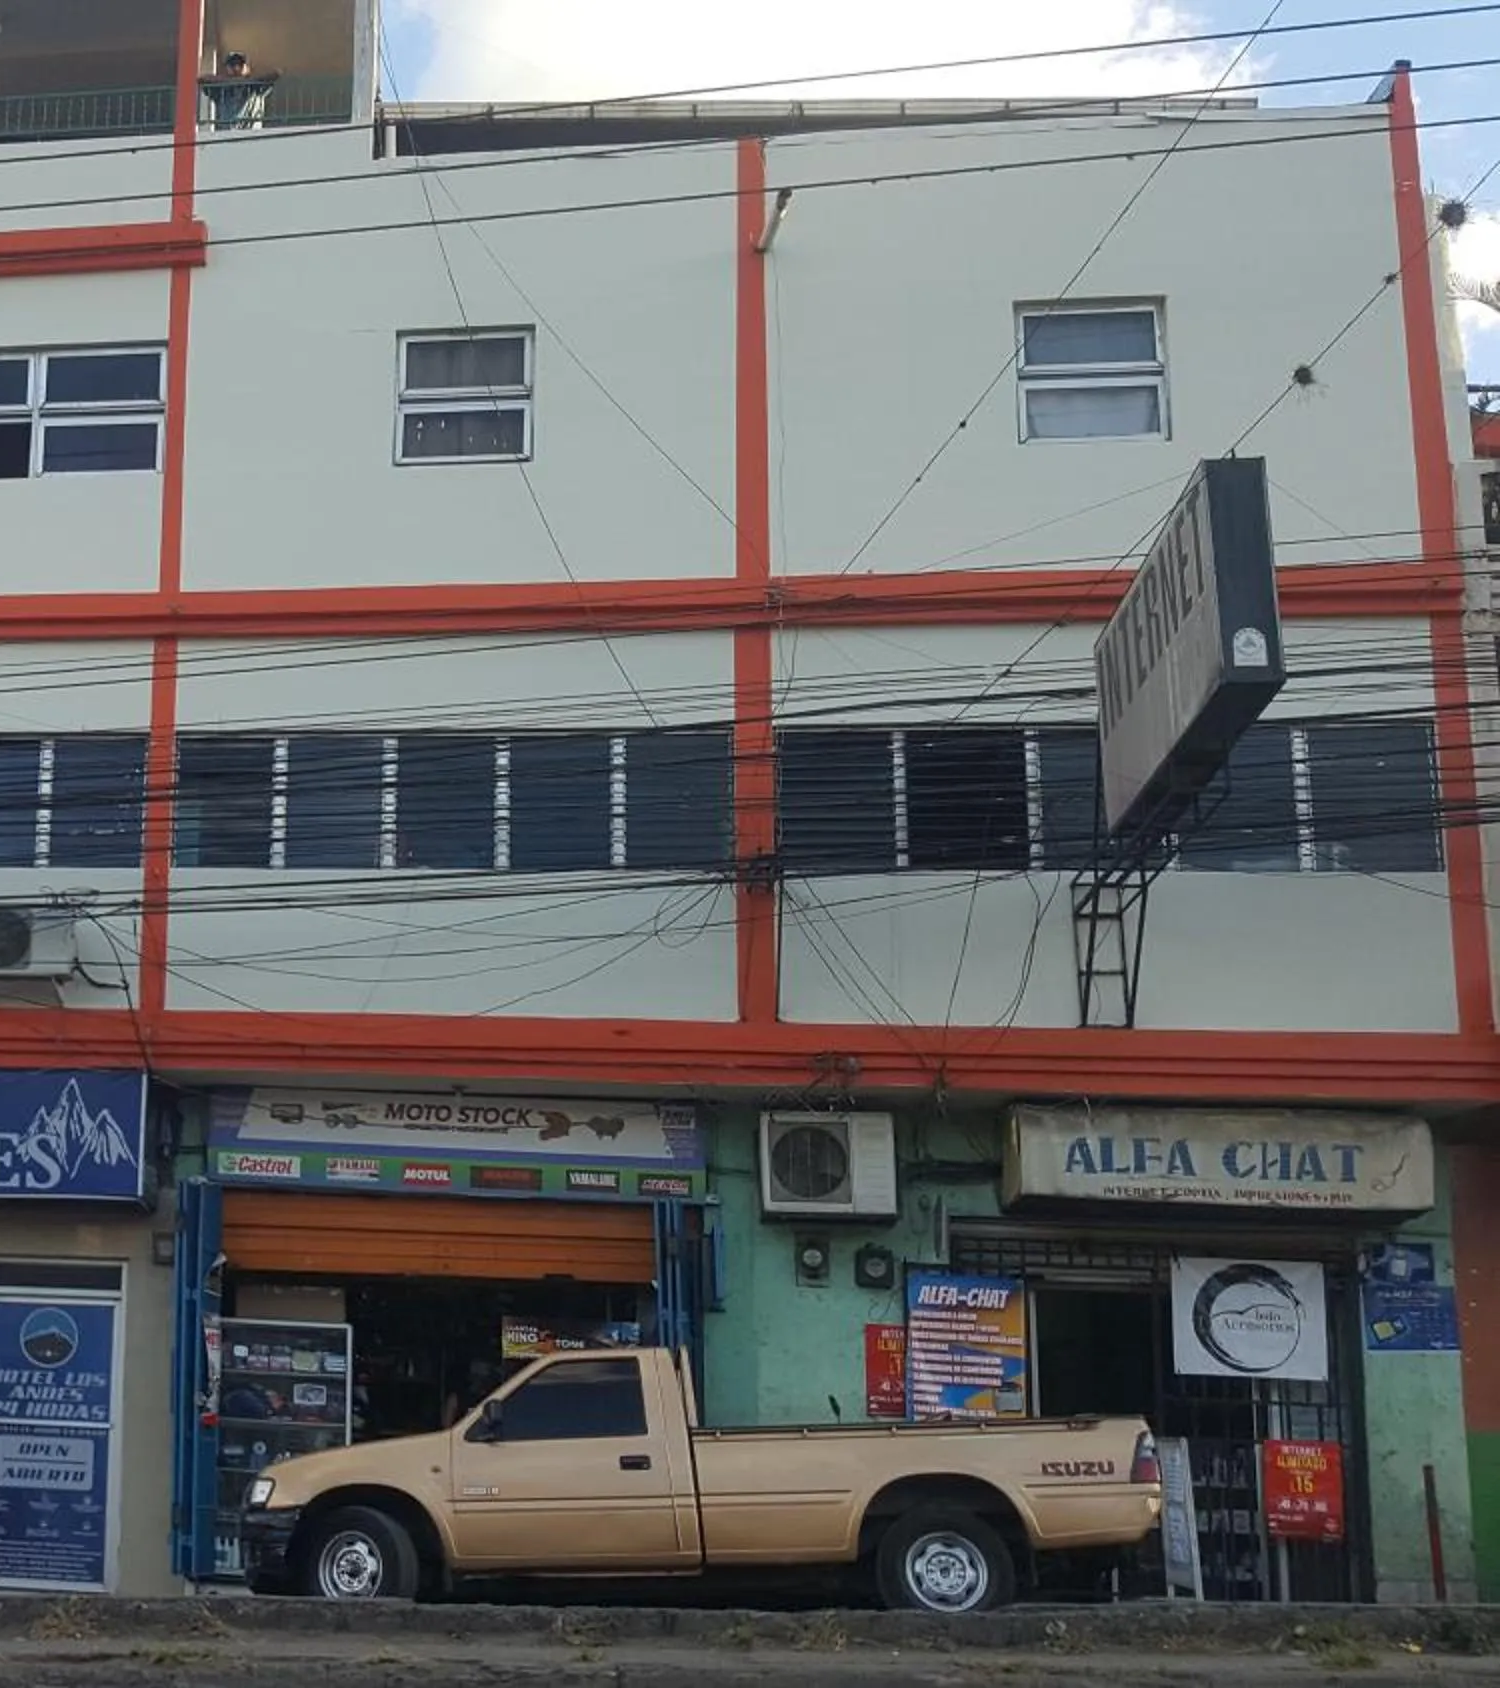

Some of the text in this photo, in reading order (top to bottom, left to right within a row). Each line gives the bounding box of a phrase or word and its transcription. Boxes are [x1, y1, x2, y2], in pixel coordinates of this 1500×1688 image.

[1098, 487, 1208, 741] INTERNET
[385, 1103, 451, 1122] MOTO
[457, 1106, 535, 1126] STOCK
[239, 1155, 293, 1174] Castrol
[1065, 1136, 1365, 1183] ALFA CHAT
[404, 1167, 450, 1181] MOTUL
[918, 1284, 1009, 1309] ALFA-CHAT
[65, 1371, 106, 1387] LOS
[8, 1384, 84, 1402] ANDES
[25, 1401, 106, 1420] HORAS
[18, 1442, 70, 1457] OPEN
[3, 1467, 86, 1483] ABIERTO
[1041, 1460, 1115, 1477] ISUZU
